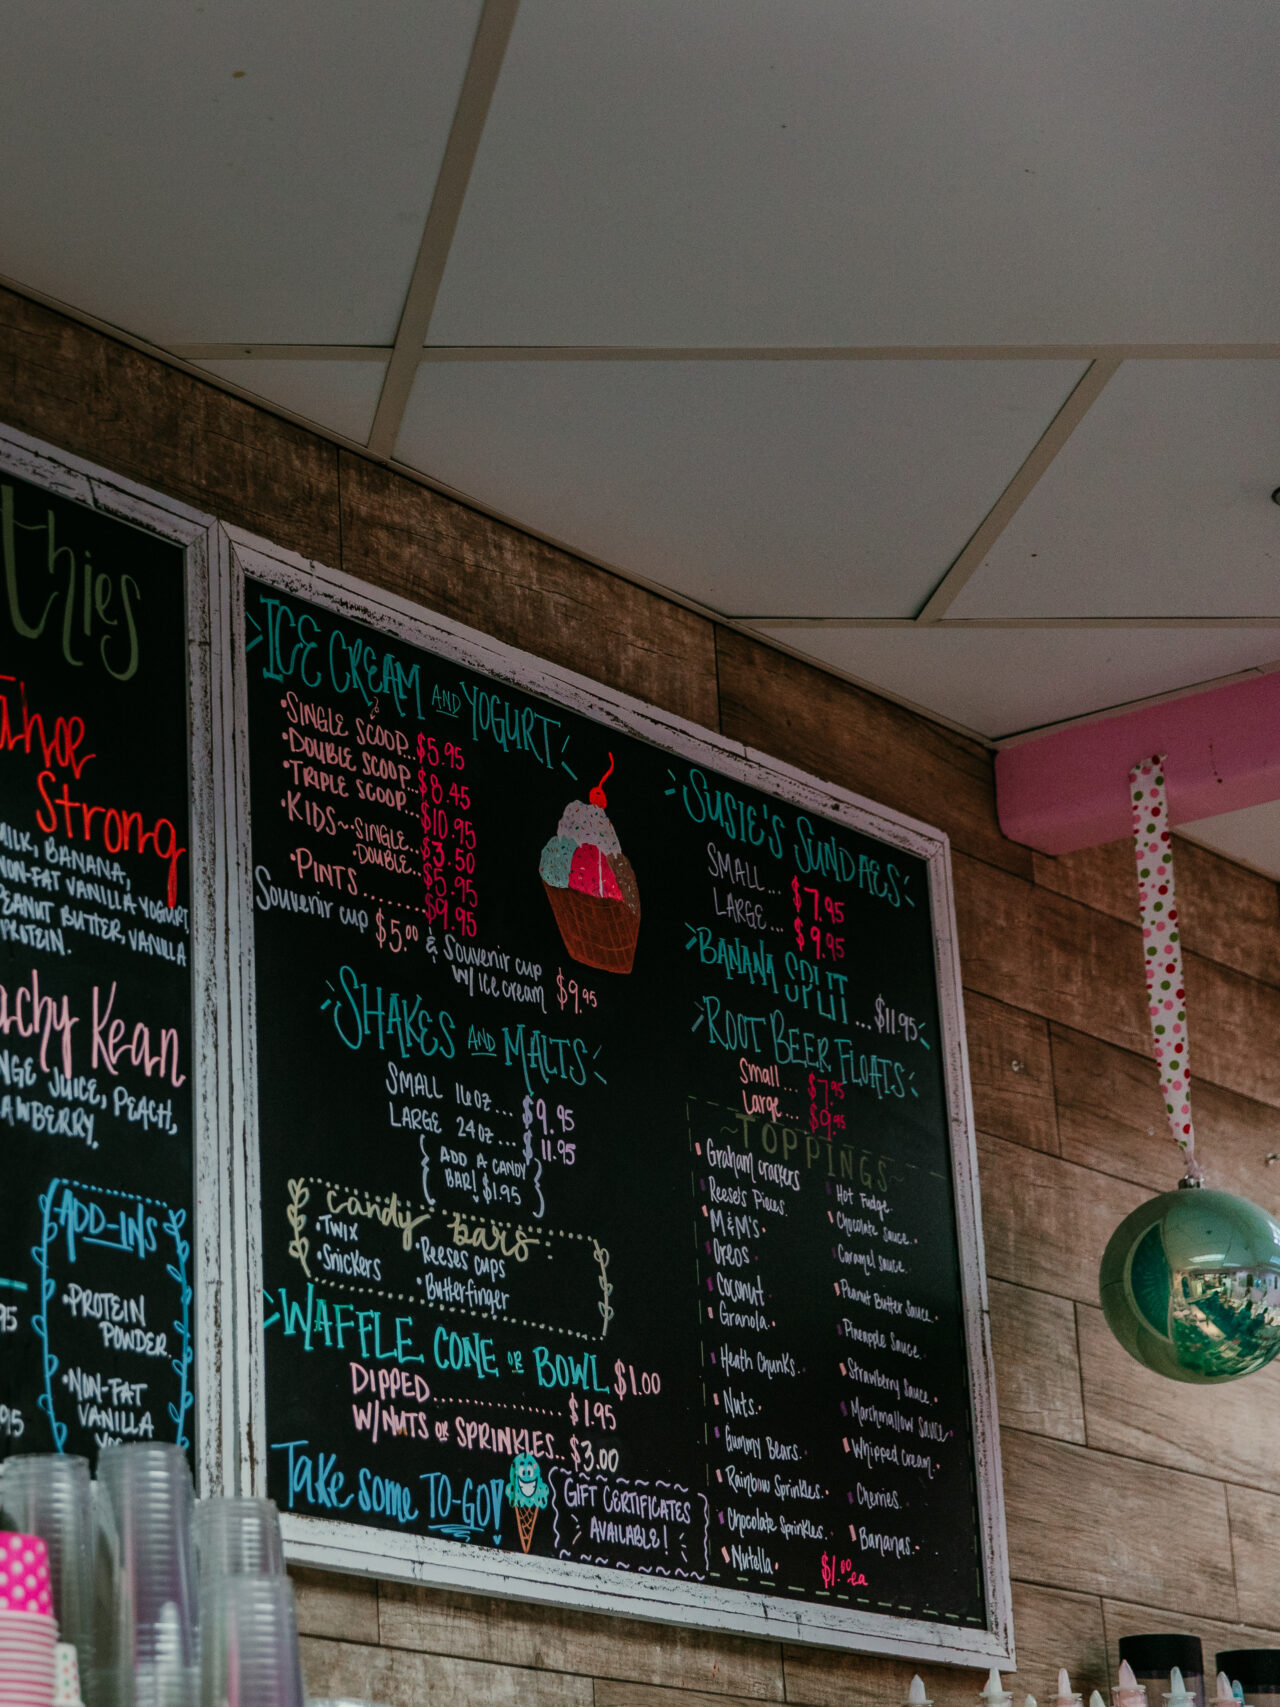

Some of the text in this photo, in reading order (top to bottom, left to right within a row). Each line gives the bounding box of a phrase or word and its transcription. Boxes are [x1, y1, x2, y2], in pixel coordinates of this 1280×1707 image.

[260, 595, 561, 769] ICE CREAM AND YOGURT
[285, 691, 349, 737] SINGLE
[289, 728, 357, 771] DOUBLE
[289, 760, 349, 798] TRIPLE
[286, 792, 338, 836] KIDS
[36, 771, 186, 909] Strong
[683, 769, 901, 907] SUSIE'S SUNDAES
[295, 848, 358, 896] PINTS
[66, 876, 137, 914] VANILLA
[255, 866, 334, 920] Souvenir
[340, 903, 368, 934] cup
[444, 934, 543, 988] Souvenir cup
[696, 926, 779, 995] BANANA
[784, 952, 848, 1025] SPLIT
[503, 979, 547, 1015] cream
[92, 981, 186, 1089] Kean
[333, 965, 587, 1096] SHAKES AND MALTS
[702, 996, 906, 1099] ROOT BEER FLOATS
[386, 1060, 443, 1100] SMALL
[389, 1102, 442, 1134] LARGE
[440, 1146, 526, 1181] ADD CANDY
[706, 1138, 756, 1183] Graham
[735, 1113, 888, 1192] TOPPINGS
[836, 1184, 853, 1206] Hot
[54, 1189, 158, 1262] ADD-INS
[326, 1189, 430, 1251] candy
[421, 1237, 505, 1280] Reeses cups
[838, 1244, 876, 1276] Caramel
[68, 1283, 146, 1327] PROTEIN
[425, 1273, 510, 1315] Butterfinger
[717, 1271, 764, 1307] Coconut
[840, 1278, 903, 1316] Peanut Butter
[278, 1282, 424, 1365] WAFFLE
[433, 1326, 499, 1379] CONE
[533, 1346, 610, 1394] BOWL
[721, 1343, 753, 1377] Heath
[848, 1357, 900, 1400] Strawberry
[349, 1362, 431, 1403] DIPPED
[77, 1404, 155, 1439] VANILLA
[851, 1396, 914, 1434] Marshmallow
[851, 1437, 898, 1469] Whipped
[358, 1467, 418, 1524] some
[563, 1479, 691, 1524] GIFT CERTIFICATES
[726, 1465, 770, 1498] Rainbow
[727, 1507, 778, 1539] Chocolate
[731, 1544, 773, 1575] Nutella
